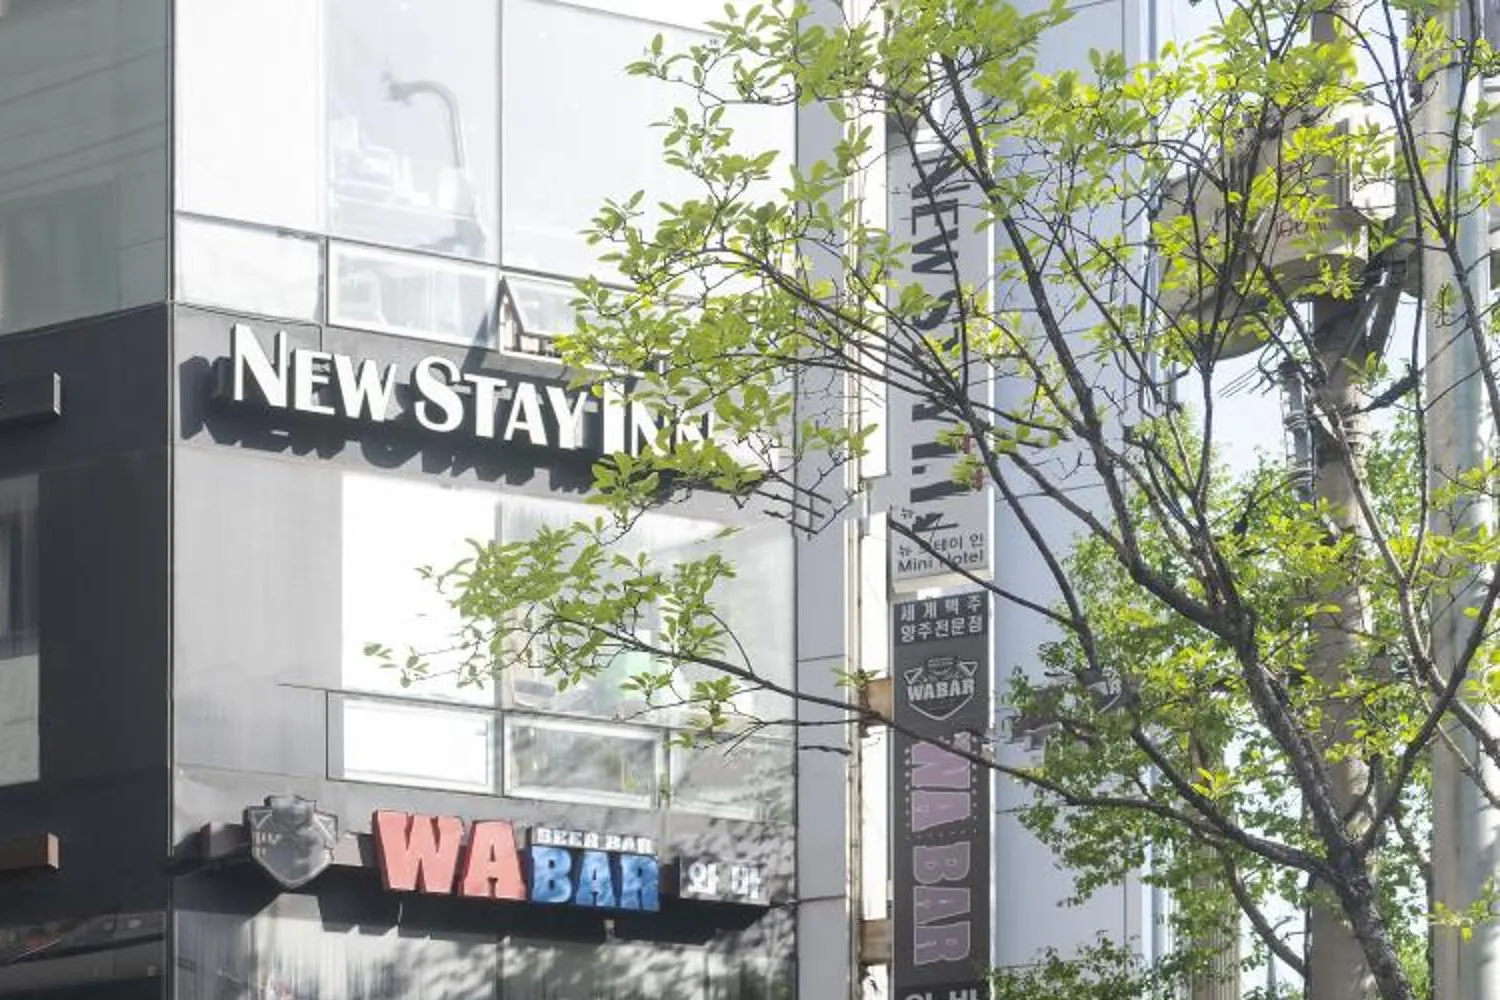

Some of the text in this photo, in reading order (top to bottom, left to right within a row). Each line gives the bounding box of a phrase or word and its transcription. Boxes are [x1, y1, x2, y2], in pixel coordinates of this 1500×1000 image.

[231, 322, 397, 422] NEW
[411, 355, 590, 450] STAY
[898, 558, 933, 573] Mini
[900, 615, 983, 643] 양주전문점
[907, 679, 975, 701] WABAR
[373, 809, 526, 900] WA
[536, 827, 653, 854] BEER BAR
[531, 845, 660, 912] BAR
